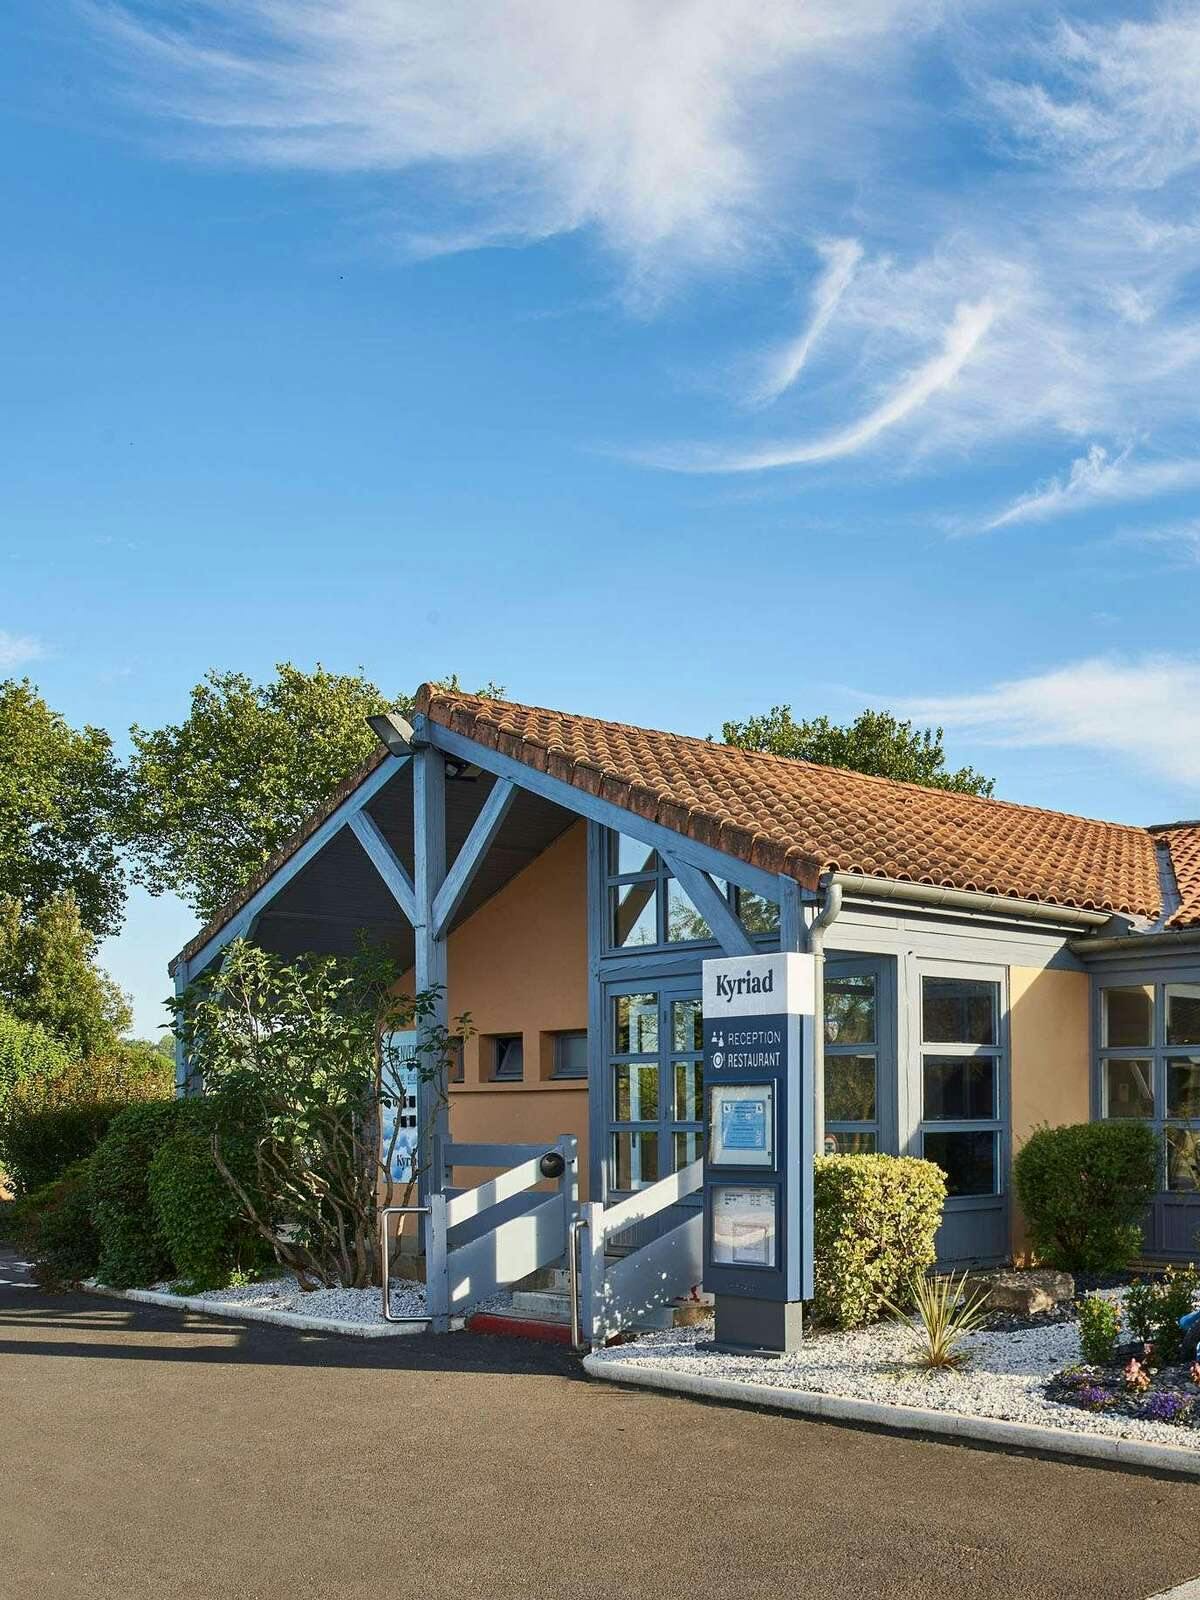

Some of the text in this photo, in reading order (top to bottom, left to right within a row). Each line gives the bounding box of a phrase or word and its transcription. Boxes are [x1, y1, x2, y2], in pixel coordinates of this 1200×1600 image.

[716, 969, 774, 1003] Kyriad
[728, 1031, 780, 1045] RECEPTION
[728, 1052, 780, 1068] RESTAURANT
